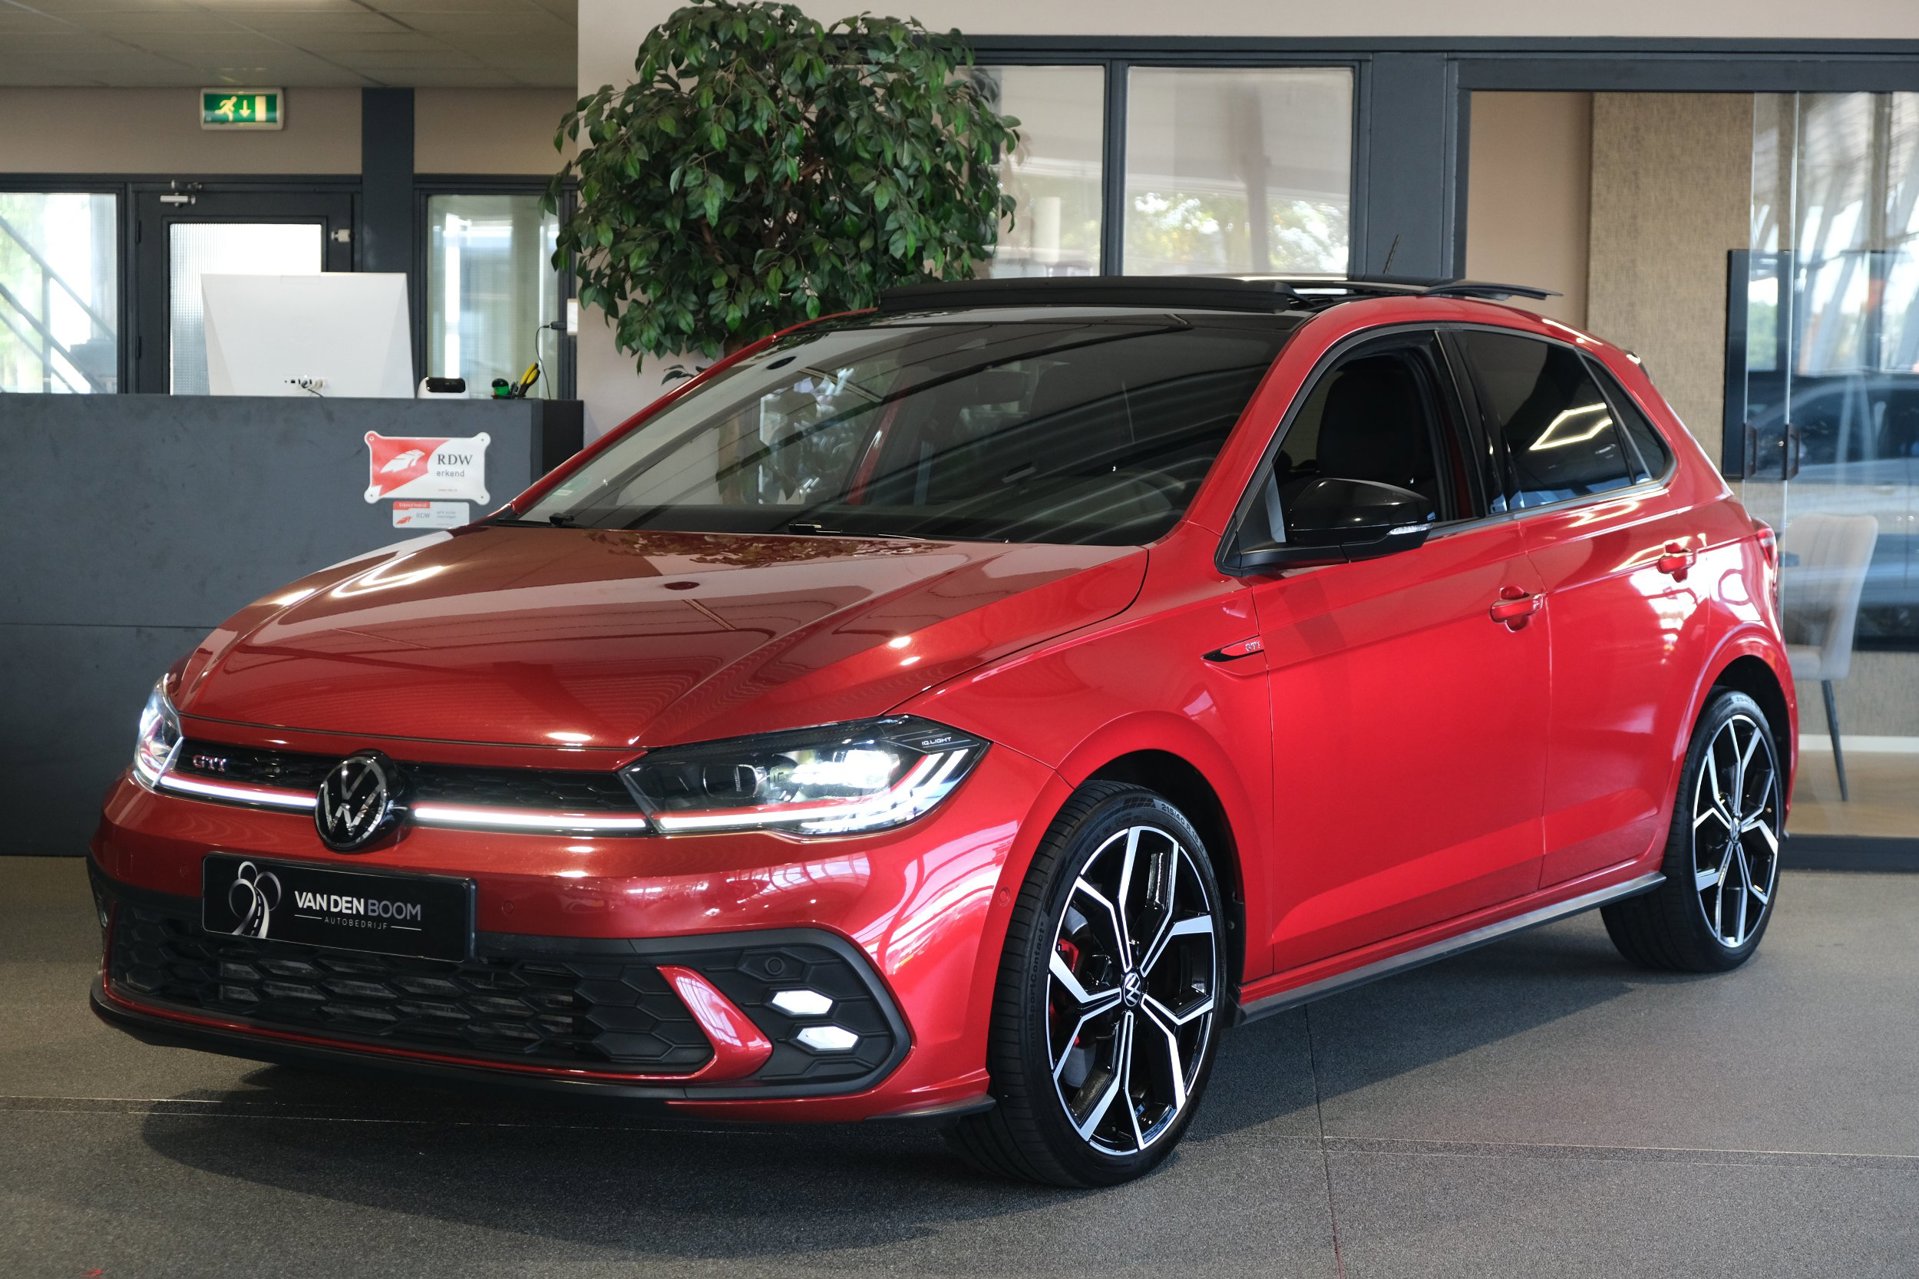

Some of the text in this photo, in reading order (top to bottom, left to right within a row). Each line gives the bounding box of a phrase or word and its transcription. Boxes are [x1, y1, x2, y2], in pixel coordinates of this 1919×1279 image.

[437, 454, 473, 465] RDW
[1245, 641, 1263, 652] GTI
[192, 754, 227, 772] GTI
[294, 890, 421, 921] VAN DEN BOOM
[324, 916, 388, 930] AUTOBEDRIJF
